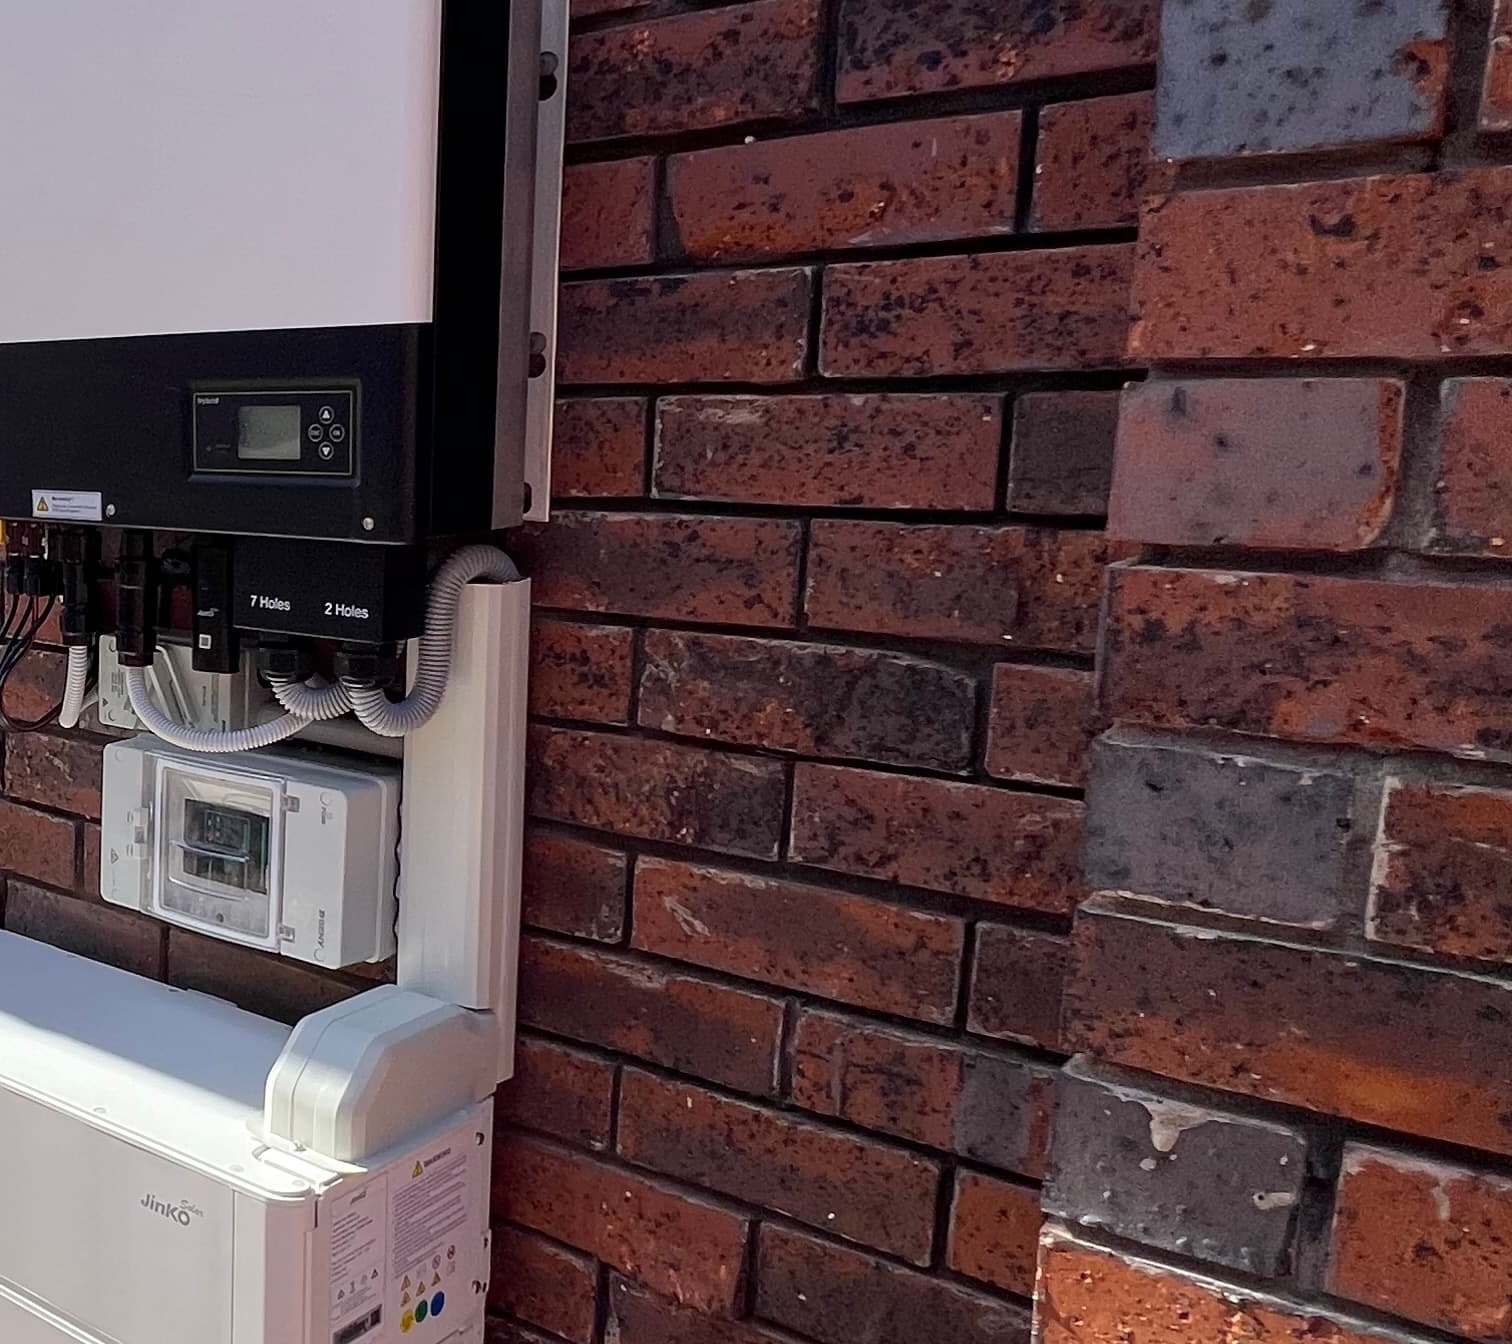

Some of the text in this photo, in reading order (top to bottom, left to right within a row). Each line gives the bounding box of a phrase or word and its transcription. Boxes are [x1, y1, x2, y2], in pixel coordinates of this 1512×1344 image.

[250, 595, 291, 611] 7 Holes
[324, 602, 369, 619] 2 Holes
[141, 1194, 190, 1226] JinKO
